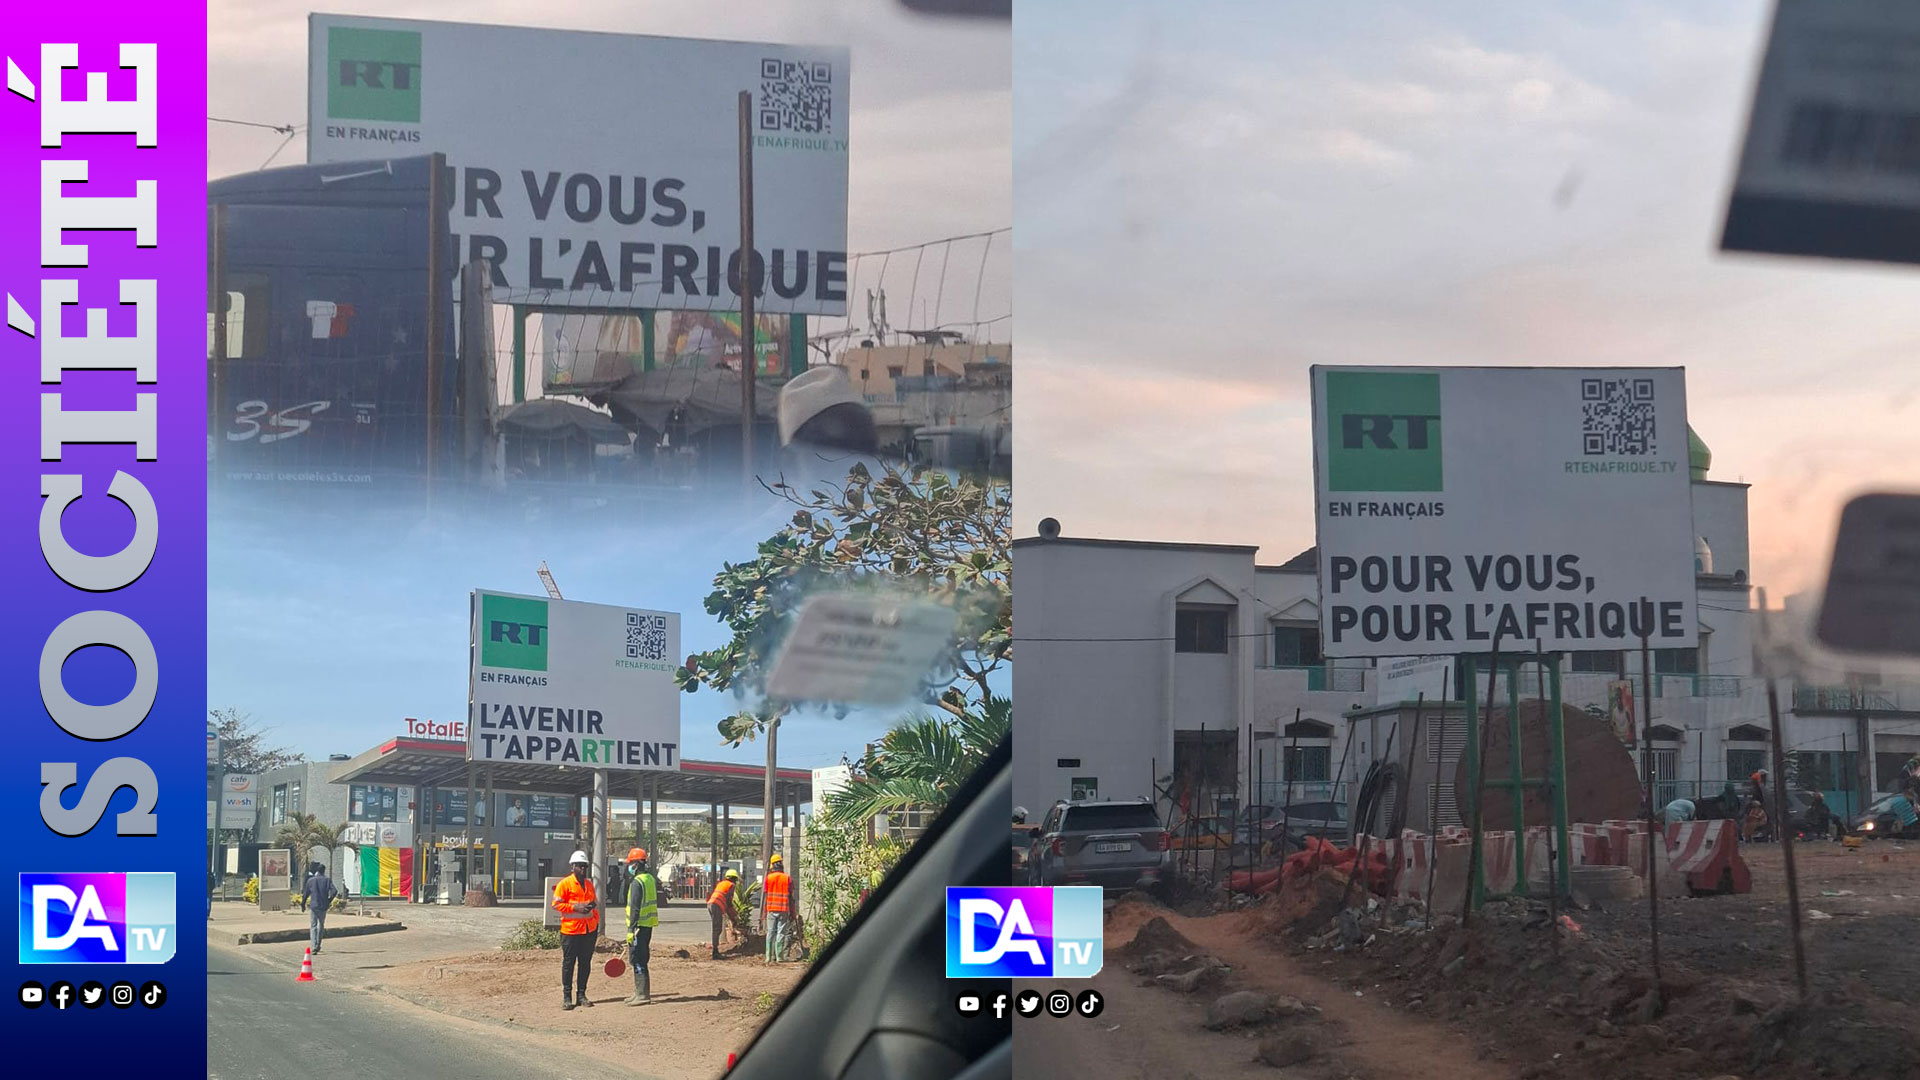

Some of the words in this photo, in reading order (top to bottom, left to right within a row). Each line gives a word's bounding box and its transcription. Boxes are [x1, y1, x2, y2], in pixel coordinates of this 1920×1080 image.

[340, 60, 421, 90] RT
[326, 126, 345, 139] EN
[350, 127, 421, 144] FRANÇAIS
[752, 135, 848, 152] TENAFRIQUE.TV
[521, 169, 706, 234] VOUS,
[528, 237, 847, 301] L'AFRIQUE
[227, 400, 331, 444] 3S
[1342, 413, 1441, 450] RT
[1564, 461, 1677, 474] RTENAFRIQUE.TV
[1329, 502, 1352, 517] EN
[1357, 502, 1445, 520] FRANÇAIS
[1330, 555, 1454, 594] POUR
[1464, 554, 1596, 594] VOUS,
[490, 620, 548, 646] RT
[1331, 603, 1454, 643] POUR
[1465, 601, 1685, 641] L'AFRIQUE
[615, 659, 677, 672] RTENAFRIQUE.TV
[481, 672, 495, 683] EN
[498, 674, 548, 688] FRANÇAIS
[480, 703, 604, 735] L'AVENIR
[481, 733, 677, 767] T'APPARTIENT
[226, 797, 252, 806] wash
[442, 833, 484, 847] bonjur
